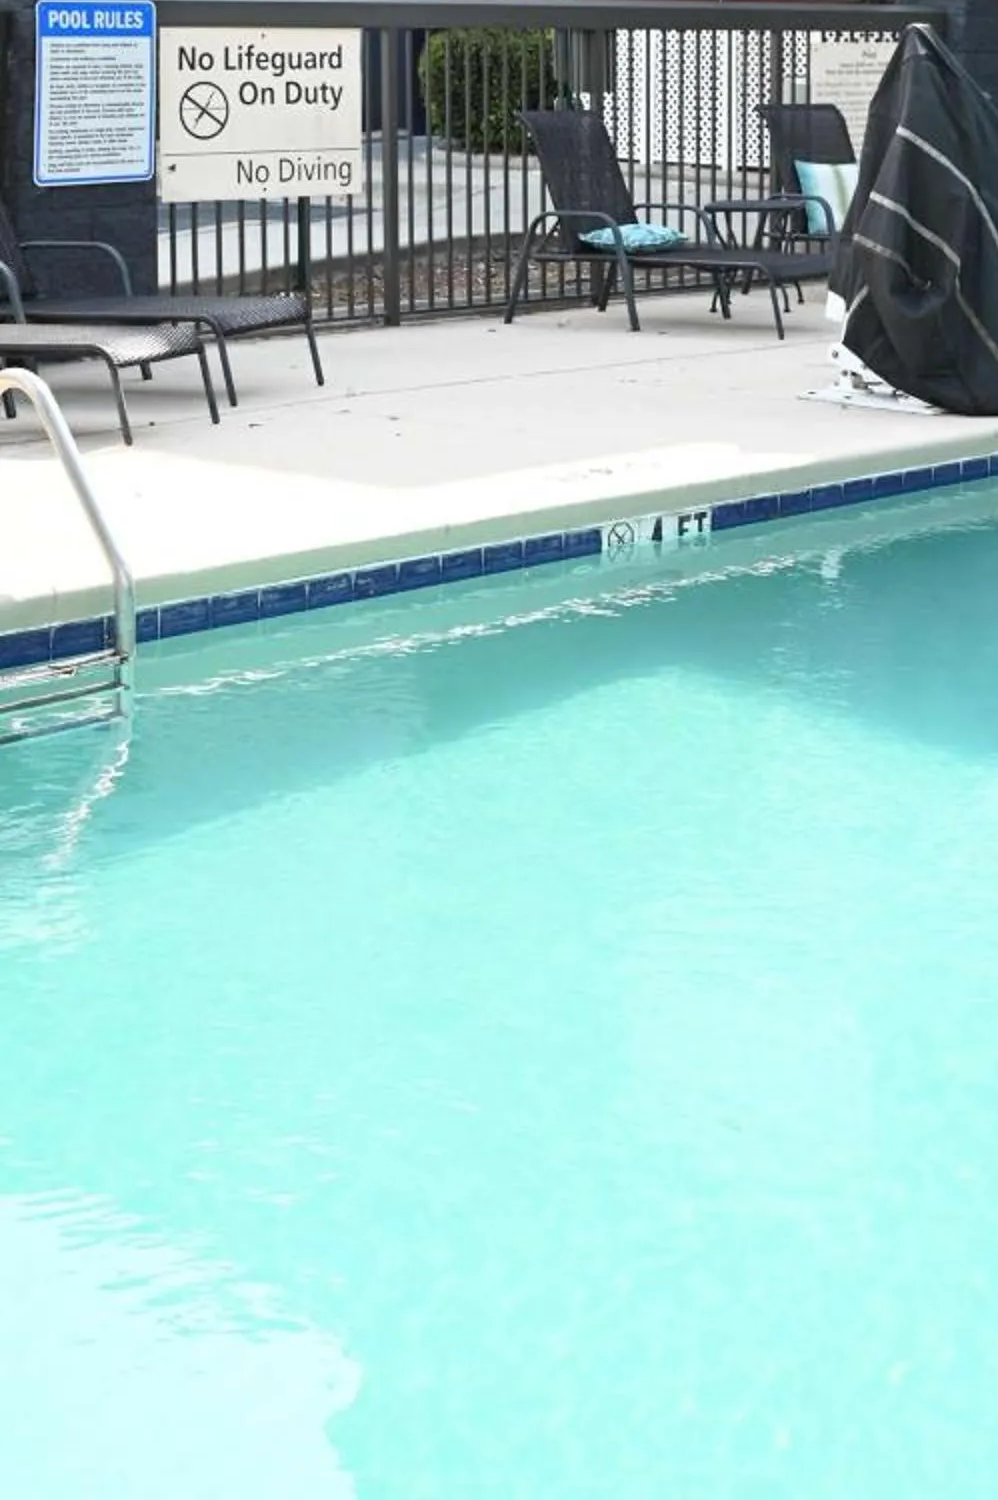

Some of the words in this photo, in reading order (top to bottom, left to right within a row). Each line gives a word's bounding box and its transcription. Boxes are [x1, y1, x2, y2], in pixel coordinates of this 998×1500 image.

[48, 10, 91, 29] POOL
[93, 10, 144, 29] RULES
[177, 46, 214, 72] No
[223, 45, 343, 77] Lifeguard
[238, 81, 275, 106] On
[285, 81, 344, 110] Duty
[237, 160, 270, 185] No
[279, 156, 352, 186] Diving
[677, 511, 708, 536] FT
